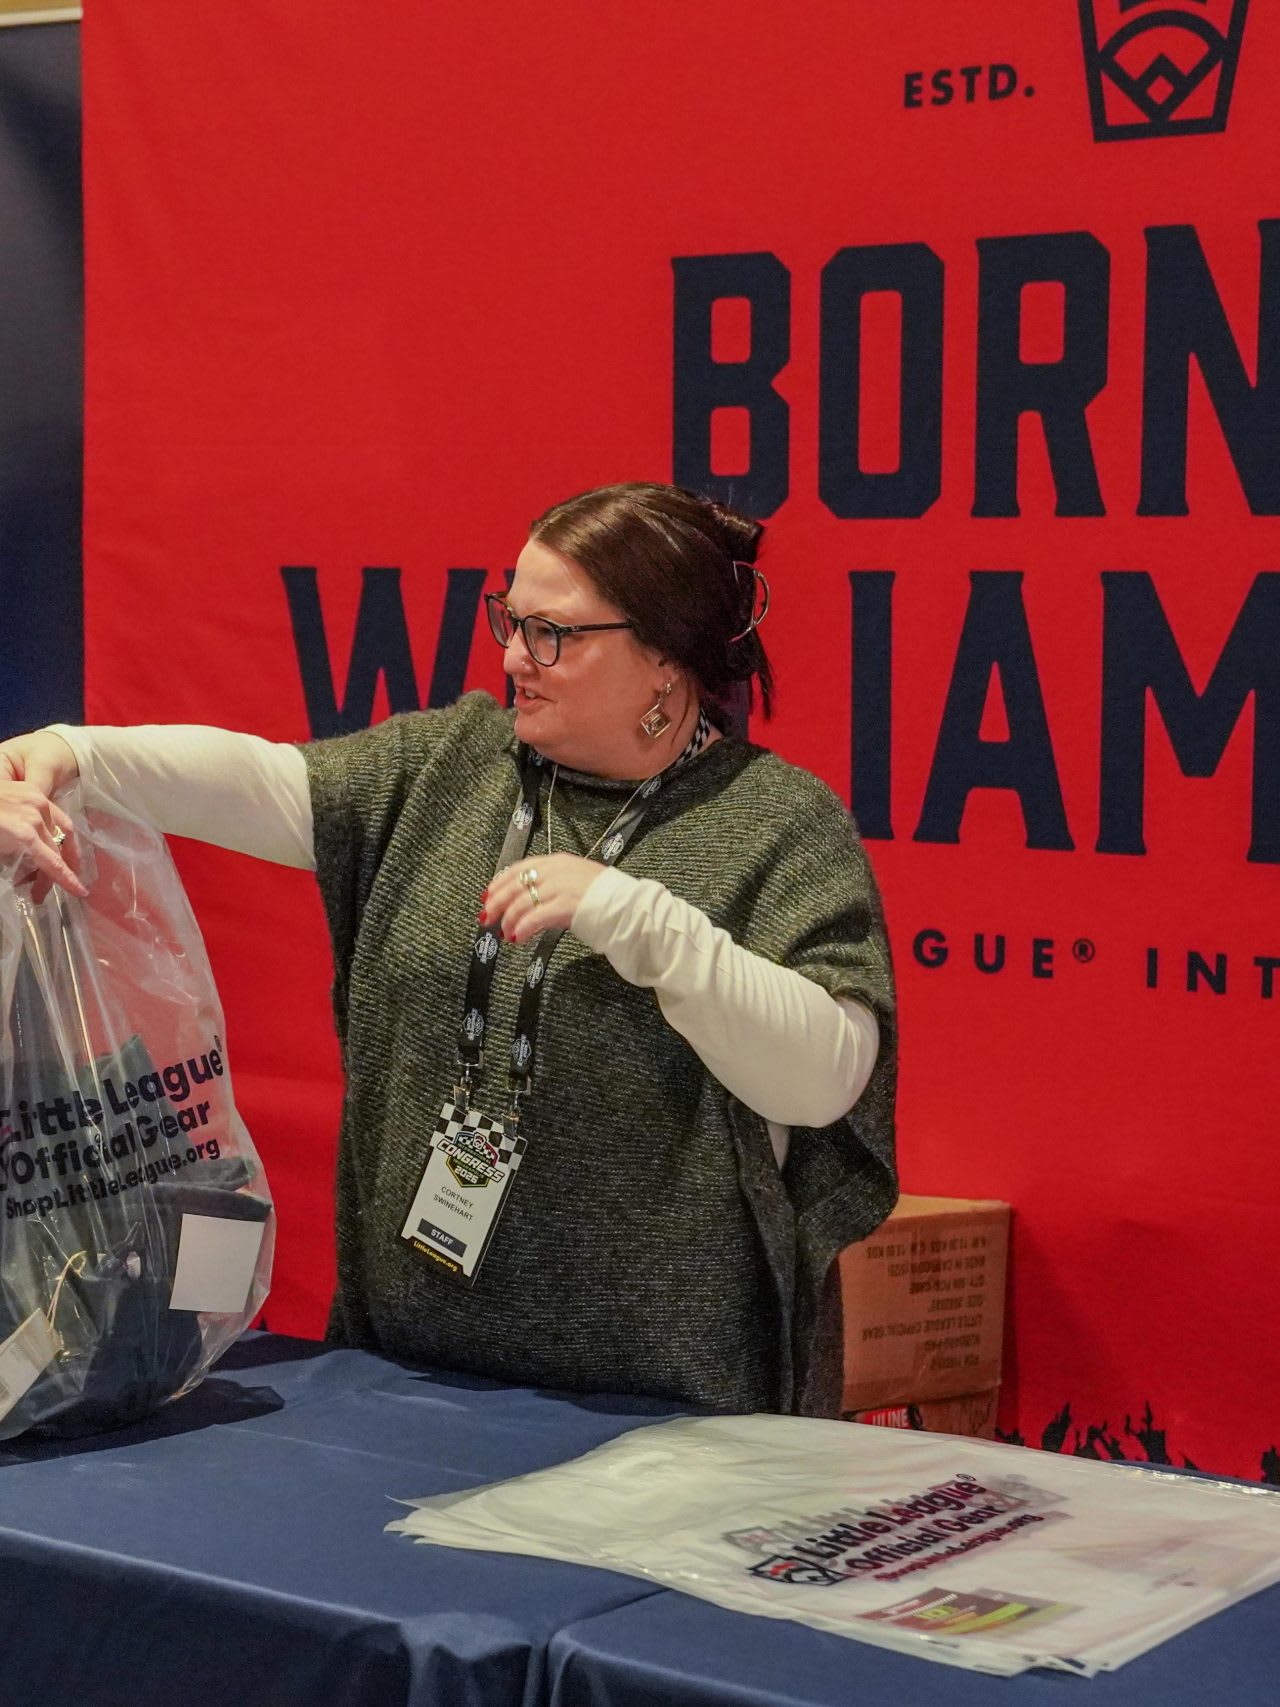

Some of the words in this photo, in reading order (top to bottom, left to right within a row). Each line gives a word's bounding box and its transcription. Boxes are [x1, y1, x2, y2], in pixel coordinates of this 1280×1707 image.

[903, 63, 1035, 108] ESTD.
[671, 218, 1280, 520] BORN
[912, 927, 1097, 982] GUE®
[10, 1120, 138, 1185] Official
[135, 1101, 211, 1150] Gear
[437, 1139, 505, 1183] CONGRESS
[454, 1165, 479, 1184] 2026
[433, 1194, 474, 1222] SWINEHART
[440, 1186, 474, 1209] CORTNEY
[413, 1240, 458, 1272] LittleLeague.org
[431, 1229, 454, 1246] STAFF
[793, 1520, 892, 1560] Little
[845, 1527, 953, 1571] Official
[931, 1504, 1006, 1533] Gear
